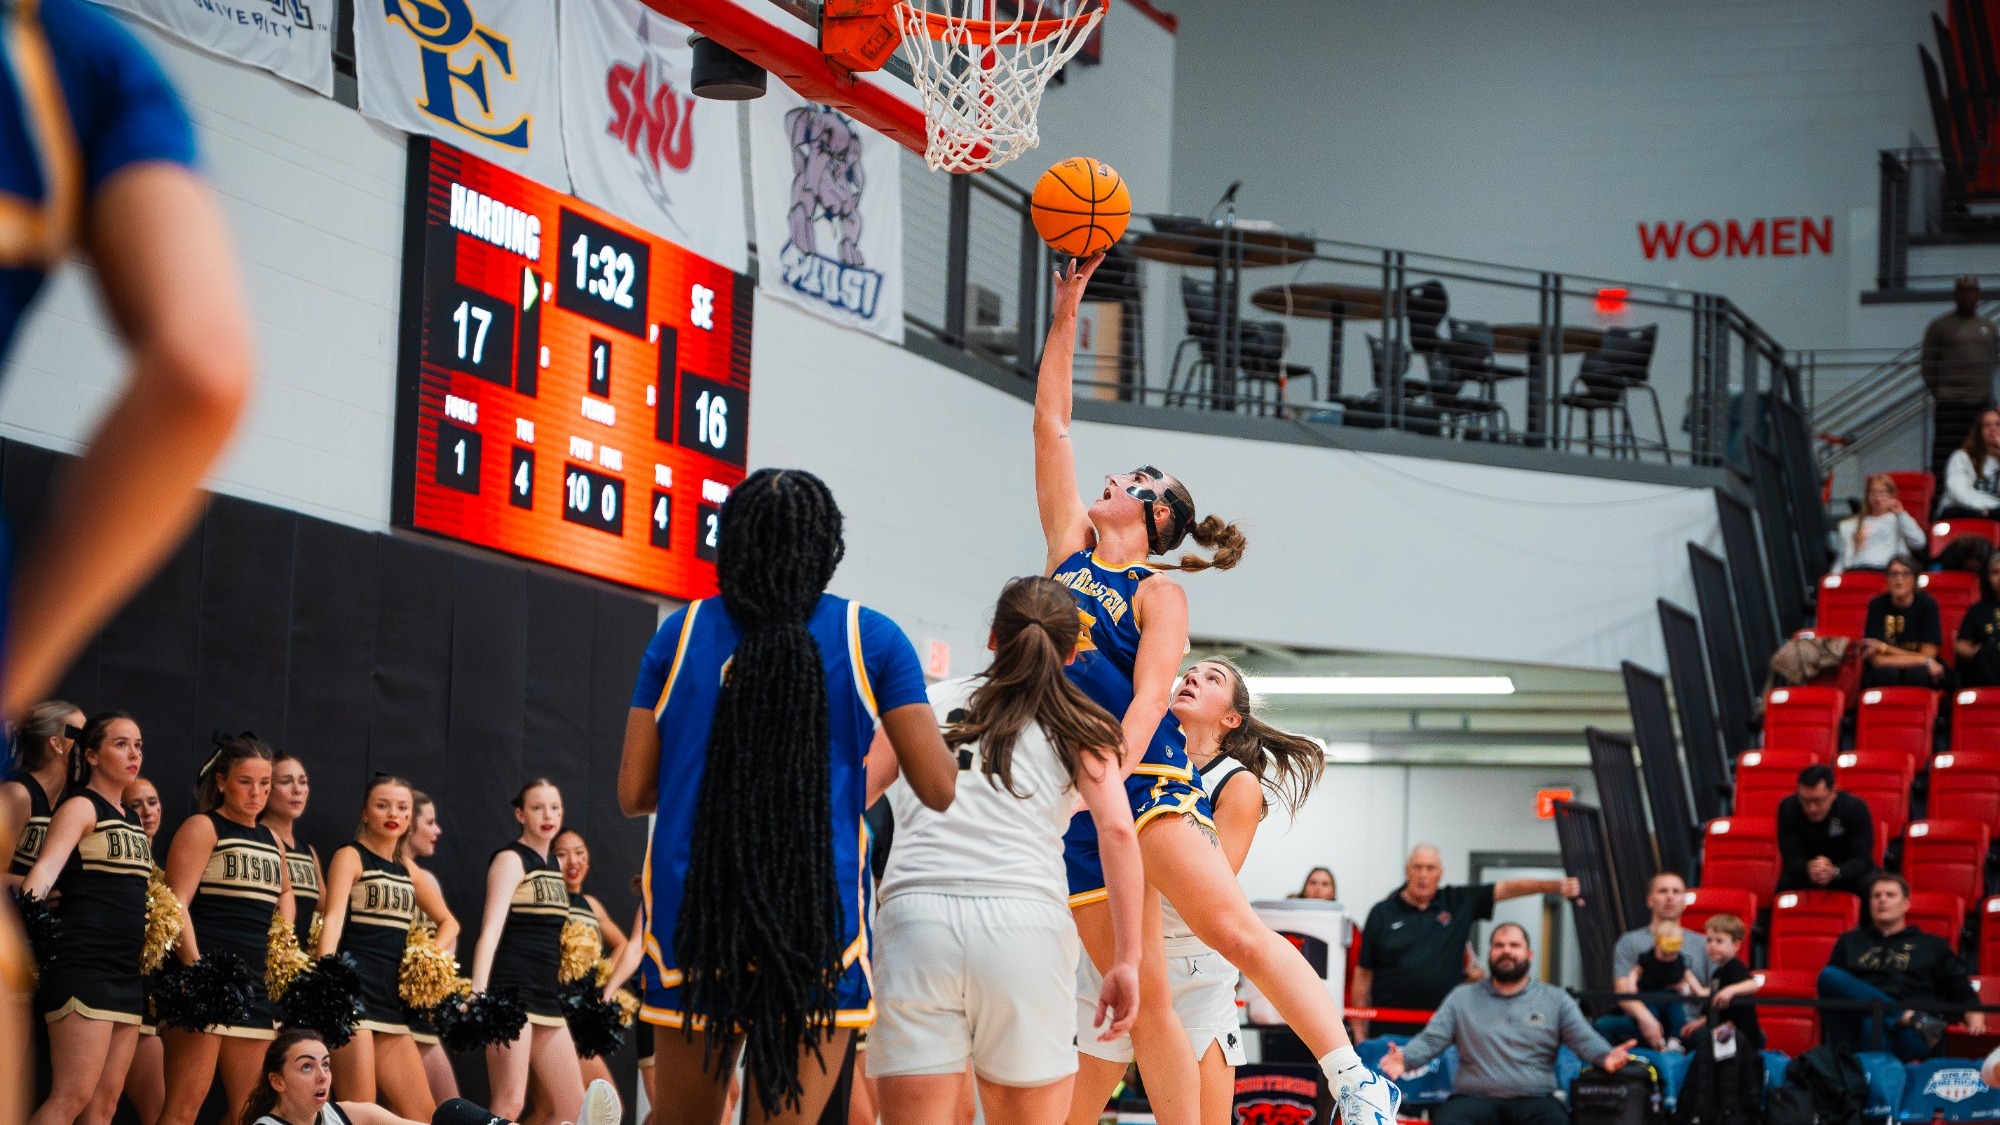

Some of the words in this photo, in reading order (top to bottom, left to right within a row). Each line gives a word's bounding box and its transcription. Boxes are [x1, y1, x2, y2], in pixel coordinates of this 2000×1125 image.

[450, 182, 542, 262] HARDING
[1637, 215, 1834, 261] WOMEN
[571, 233, 636, 310] 1:32
[690, 283, 715, 331] SE
[453, 301, 493, 365] 17
[593, 344, 605, 381] 1
[444, 394, 479, 426] FOULS
[695, 390, 728, 449] 16
[453, 438, 467, 476] 1
[514, 459, 530, 497] 4
[566, 472, 591, 513] 10
[601, 484, 617, 522] 0
[653, 496, 669, 530] 4
[705, 513, 719, 548] 2
[106, 830, 151, 864] BISO
[286, 861, 319, 887] ISO
